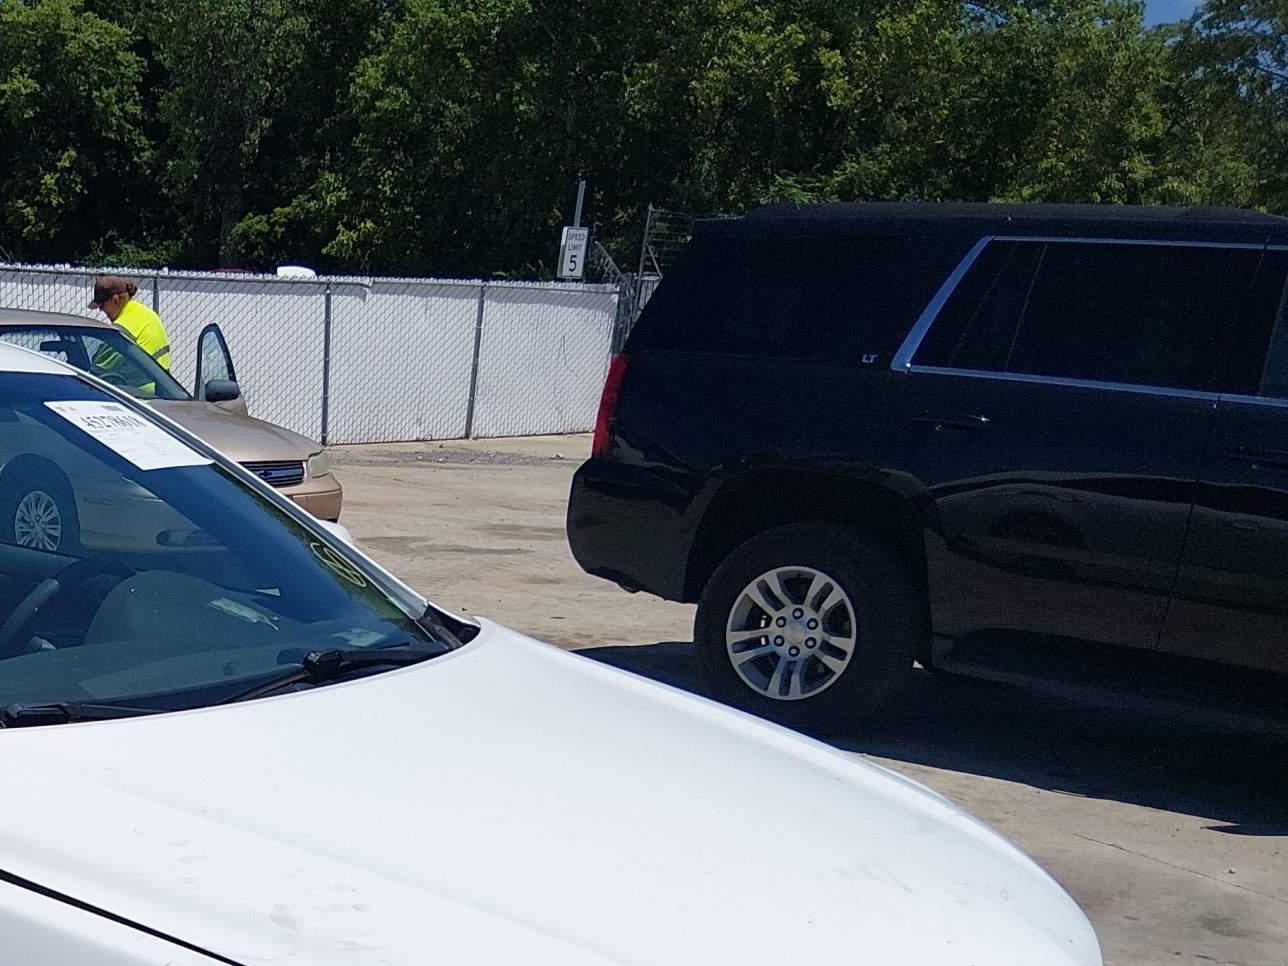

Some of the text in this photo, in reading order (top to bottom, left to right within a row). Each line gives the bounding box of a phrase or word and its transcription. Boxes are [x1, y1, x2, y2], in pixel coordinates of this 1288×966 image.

[568, 233, 586, 241] SPEED
[568, 243, 583, 251] LIMIT
[569, 254, 577, 272] 5
[862, 354, 878, 364] LT
